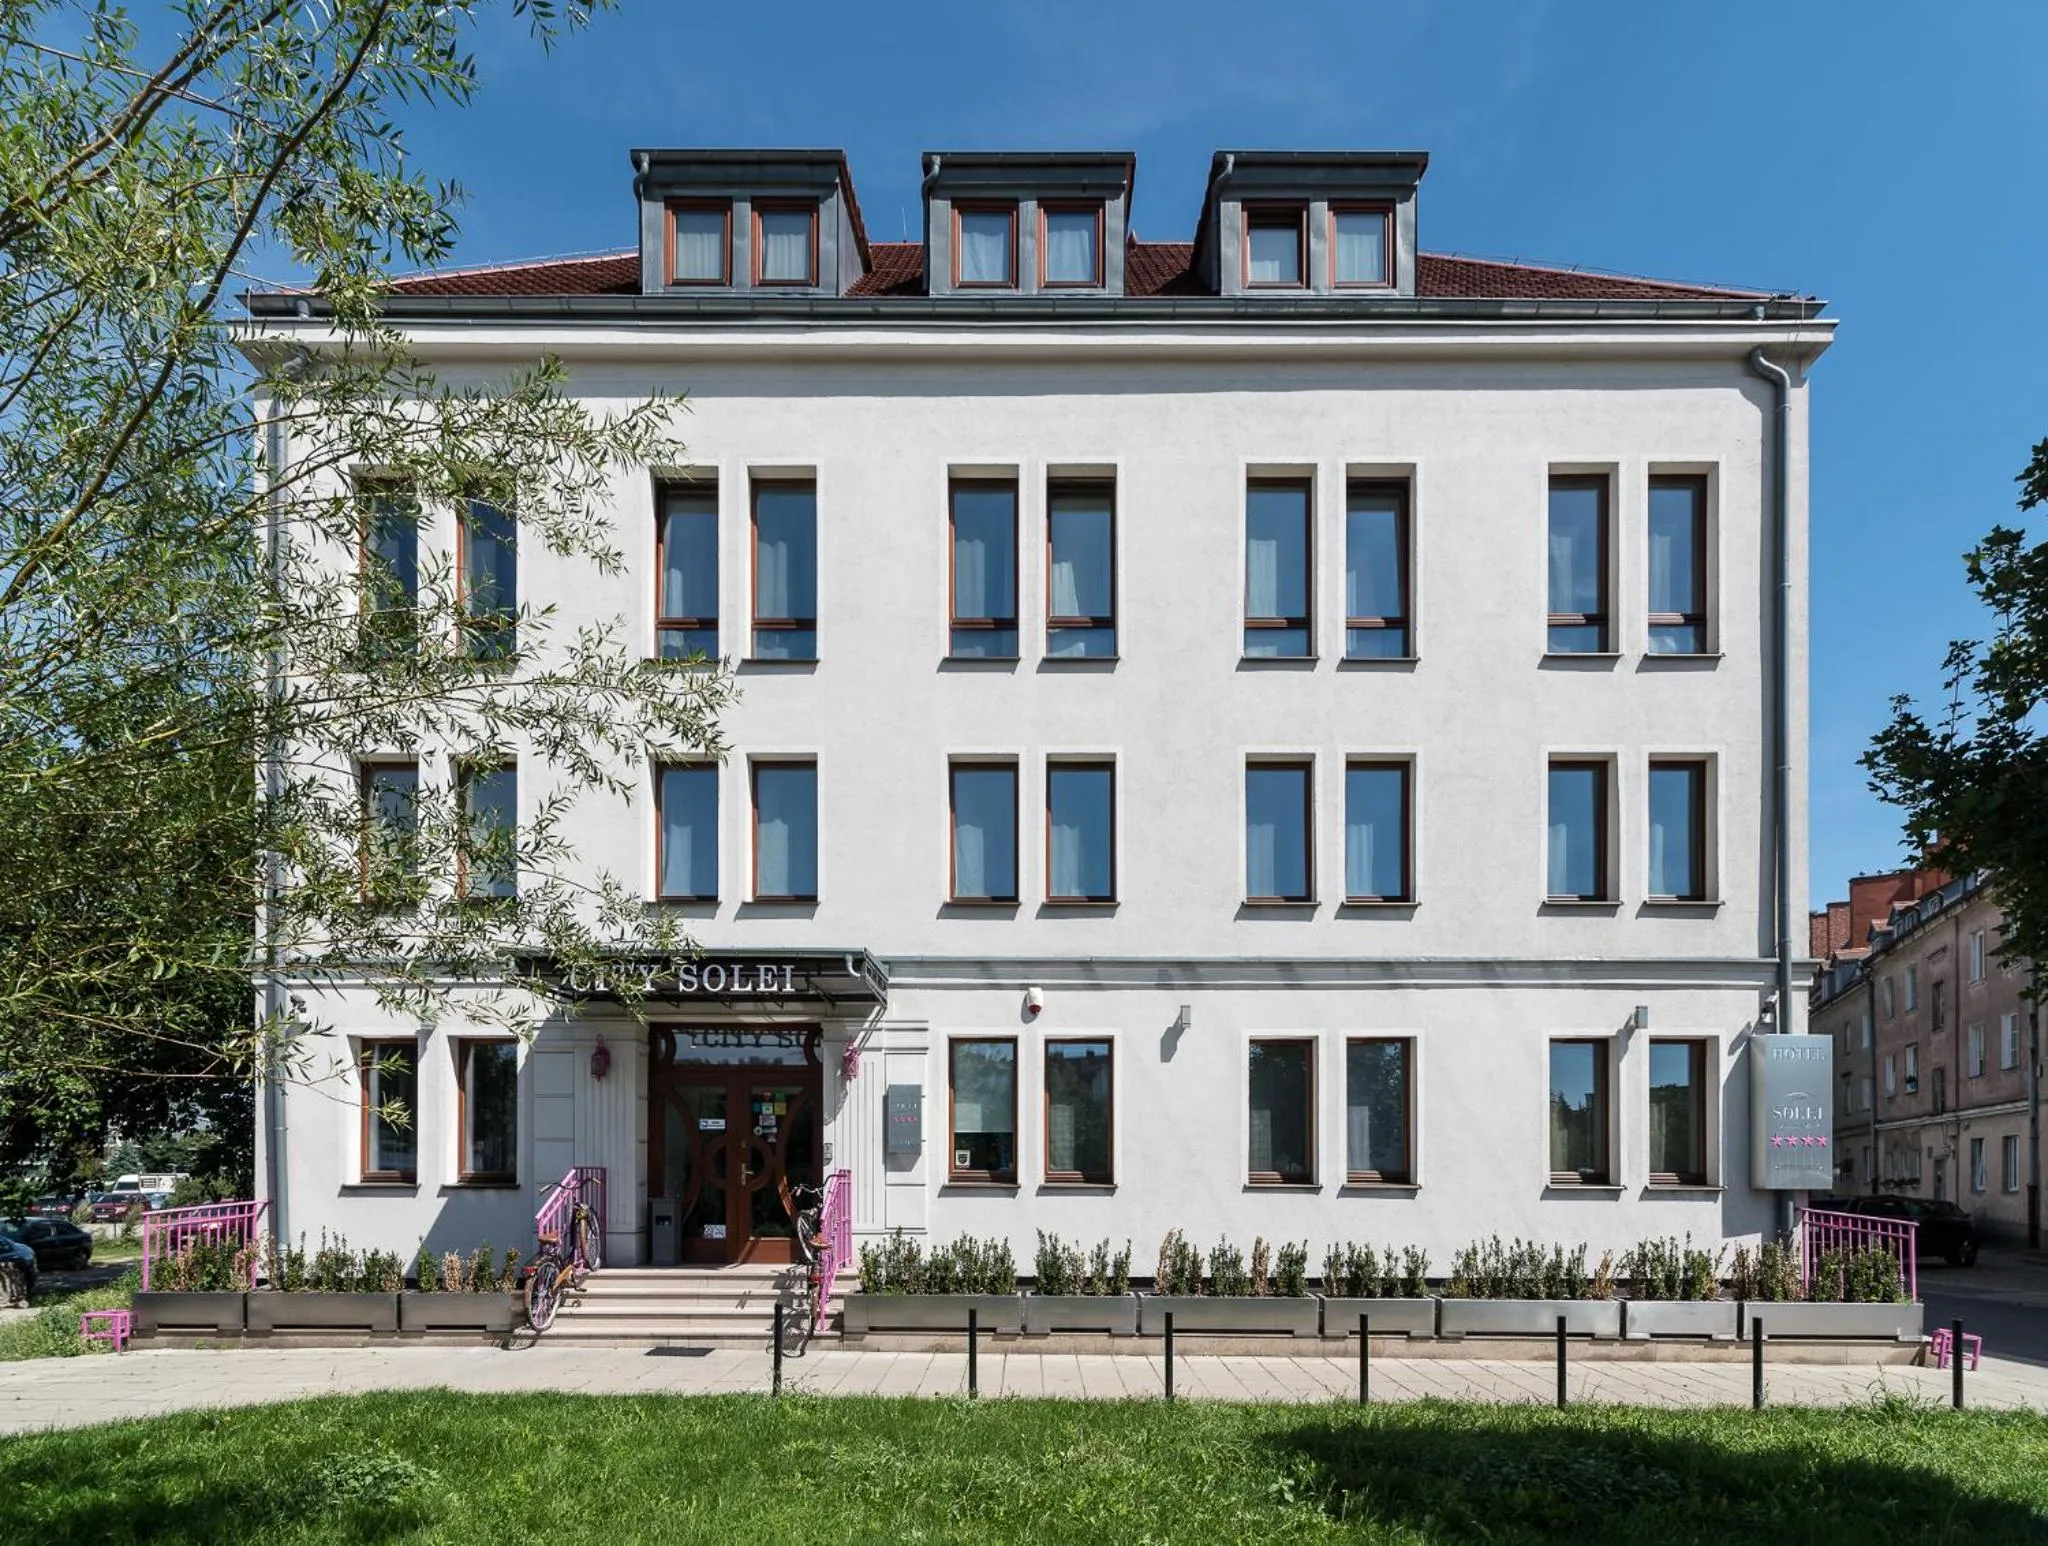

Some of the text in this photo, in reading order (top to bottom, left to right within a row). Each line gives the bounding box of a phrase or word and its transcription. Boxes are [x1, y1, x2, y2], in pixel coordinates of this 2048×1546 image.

[679, 964, 796, 993] SOLEI
[1772, 1047, 1825, 1061] HOTEL
[1772, 1105, 1823, 1120] SOLEI
